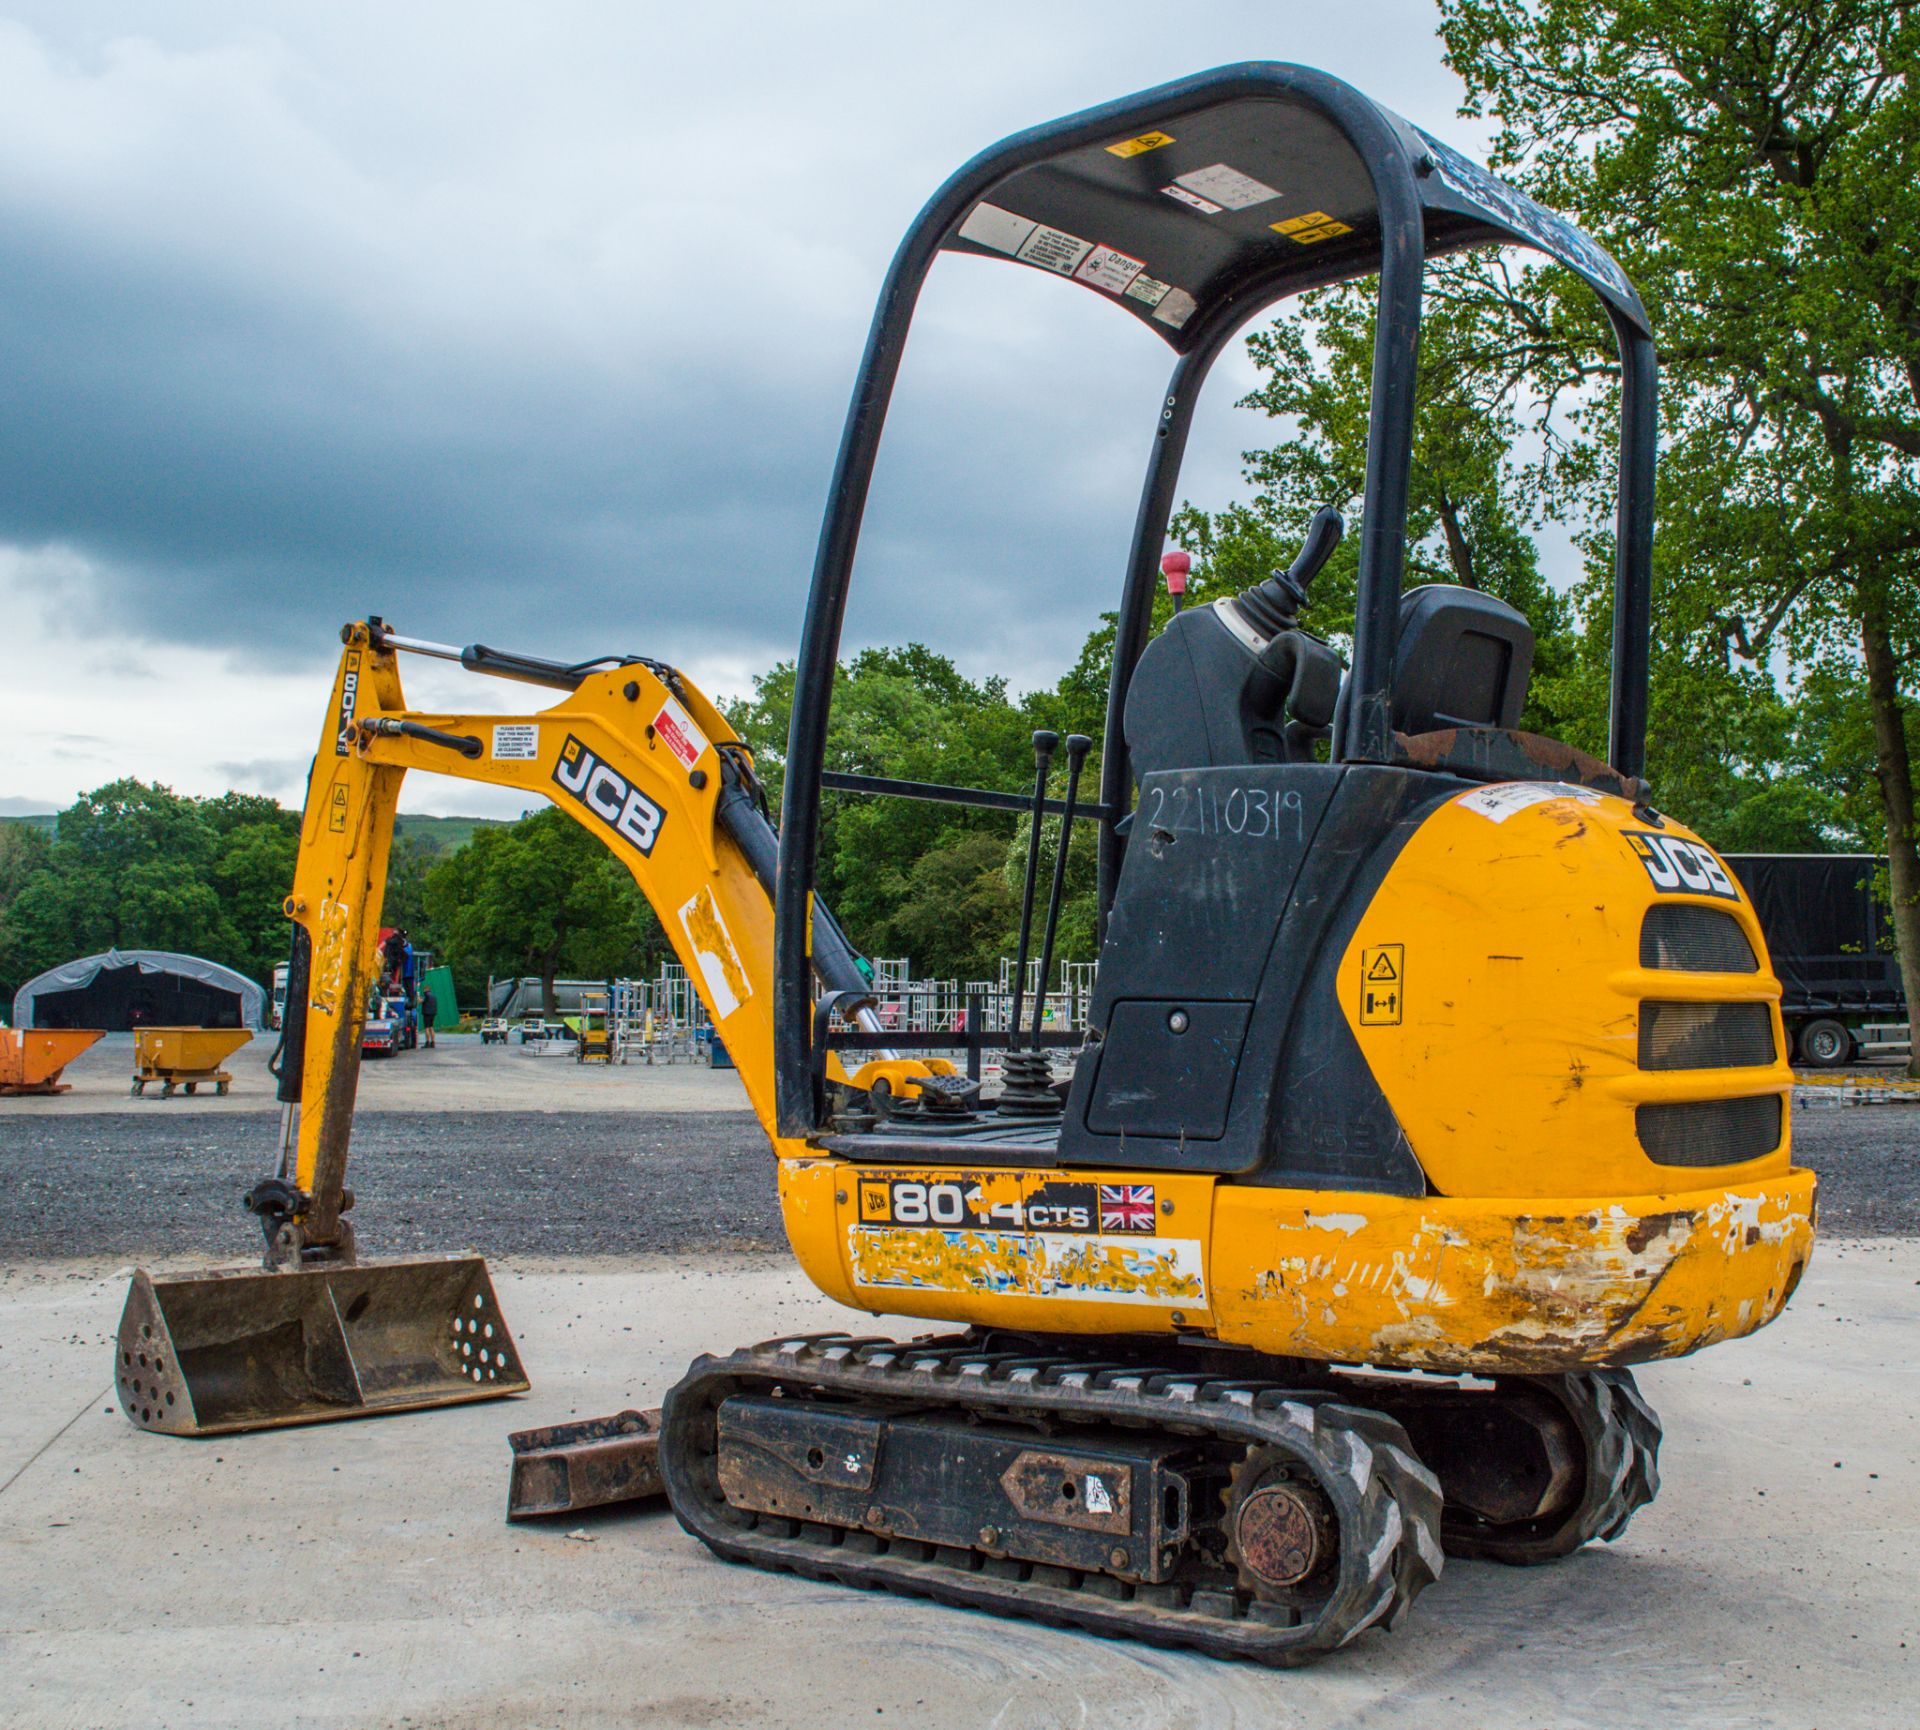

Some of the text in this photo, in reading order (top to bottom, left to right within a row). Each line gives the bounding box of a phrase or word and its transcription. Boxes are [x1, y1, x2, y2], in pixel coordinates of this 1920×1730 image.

[1108, 252, 1142, 272] Danger
[557, 752, 660, 850] JCB
[1149, 785, 1302, 842] 22110319
[1644, 835, 1735, 896] JCB
[867, 1191, 887, 1212] JCB
[1028, 1205, 1090, 1228] CTS
